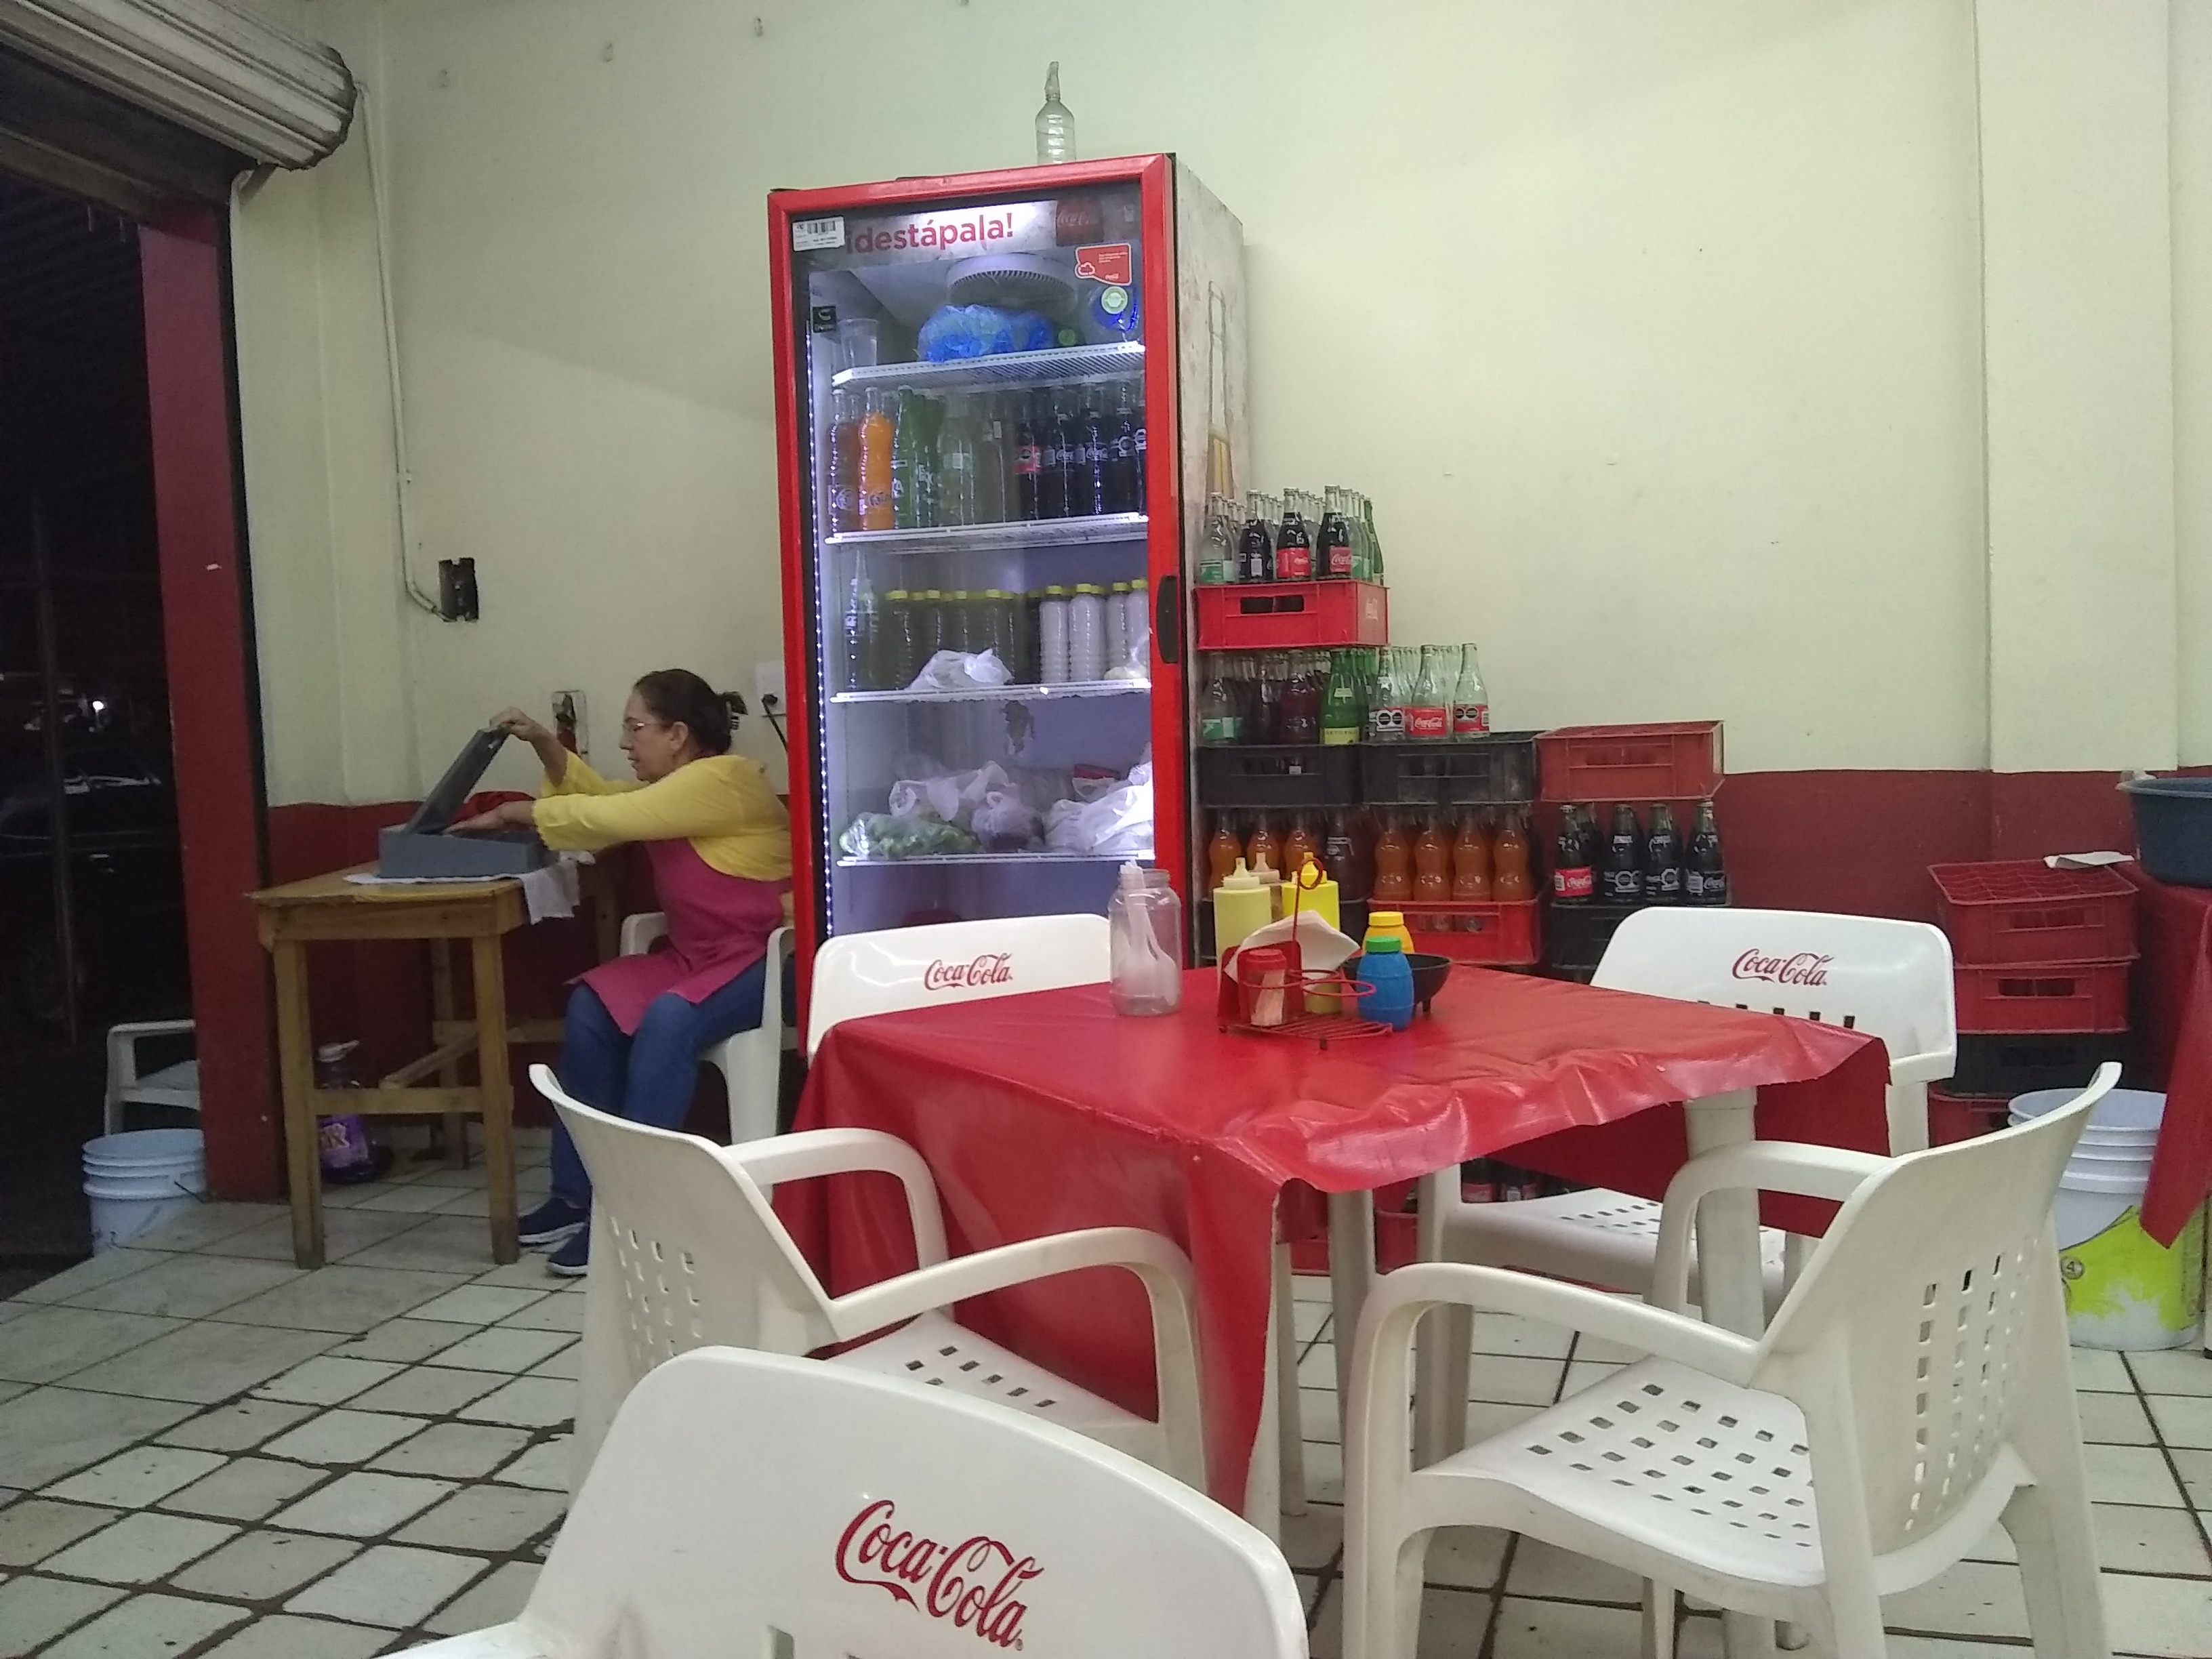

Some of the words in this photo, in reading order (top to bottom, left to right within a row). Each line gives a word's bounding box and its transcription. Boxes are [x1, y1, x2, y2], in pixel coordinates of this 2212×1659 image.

[924, 952, 1012, 991] Coca-Cola
[1732, 948, 1835, 986] Coca-Cola
[835, 1499, 1045, 1648] Coca-Cola
